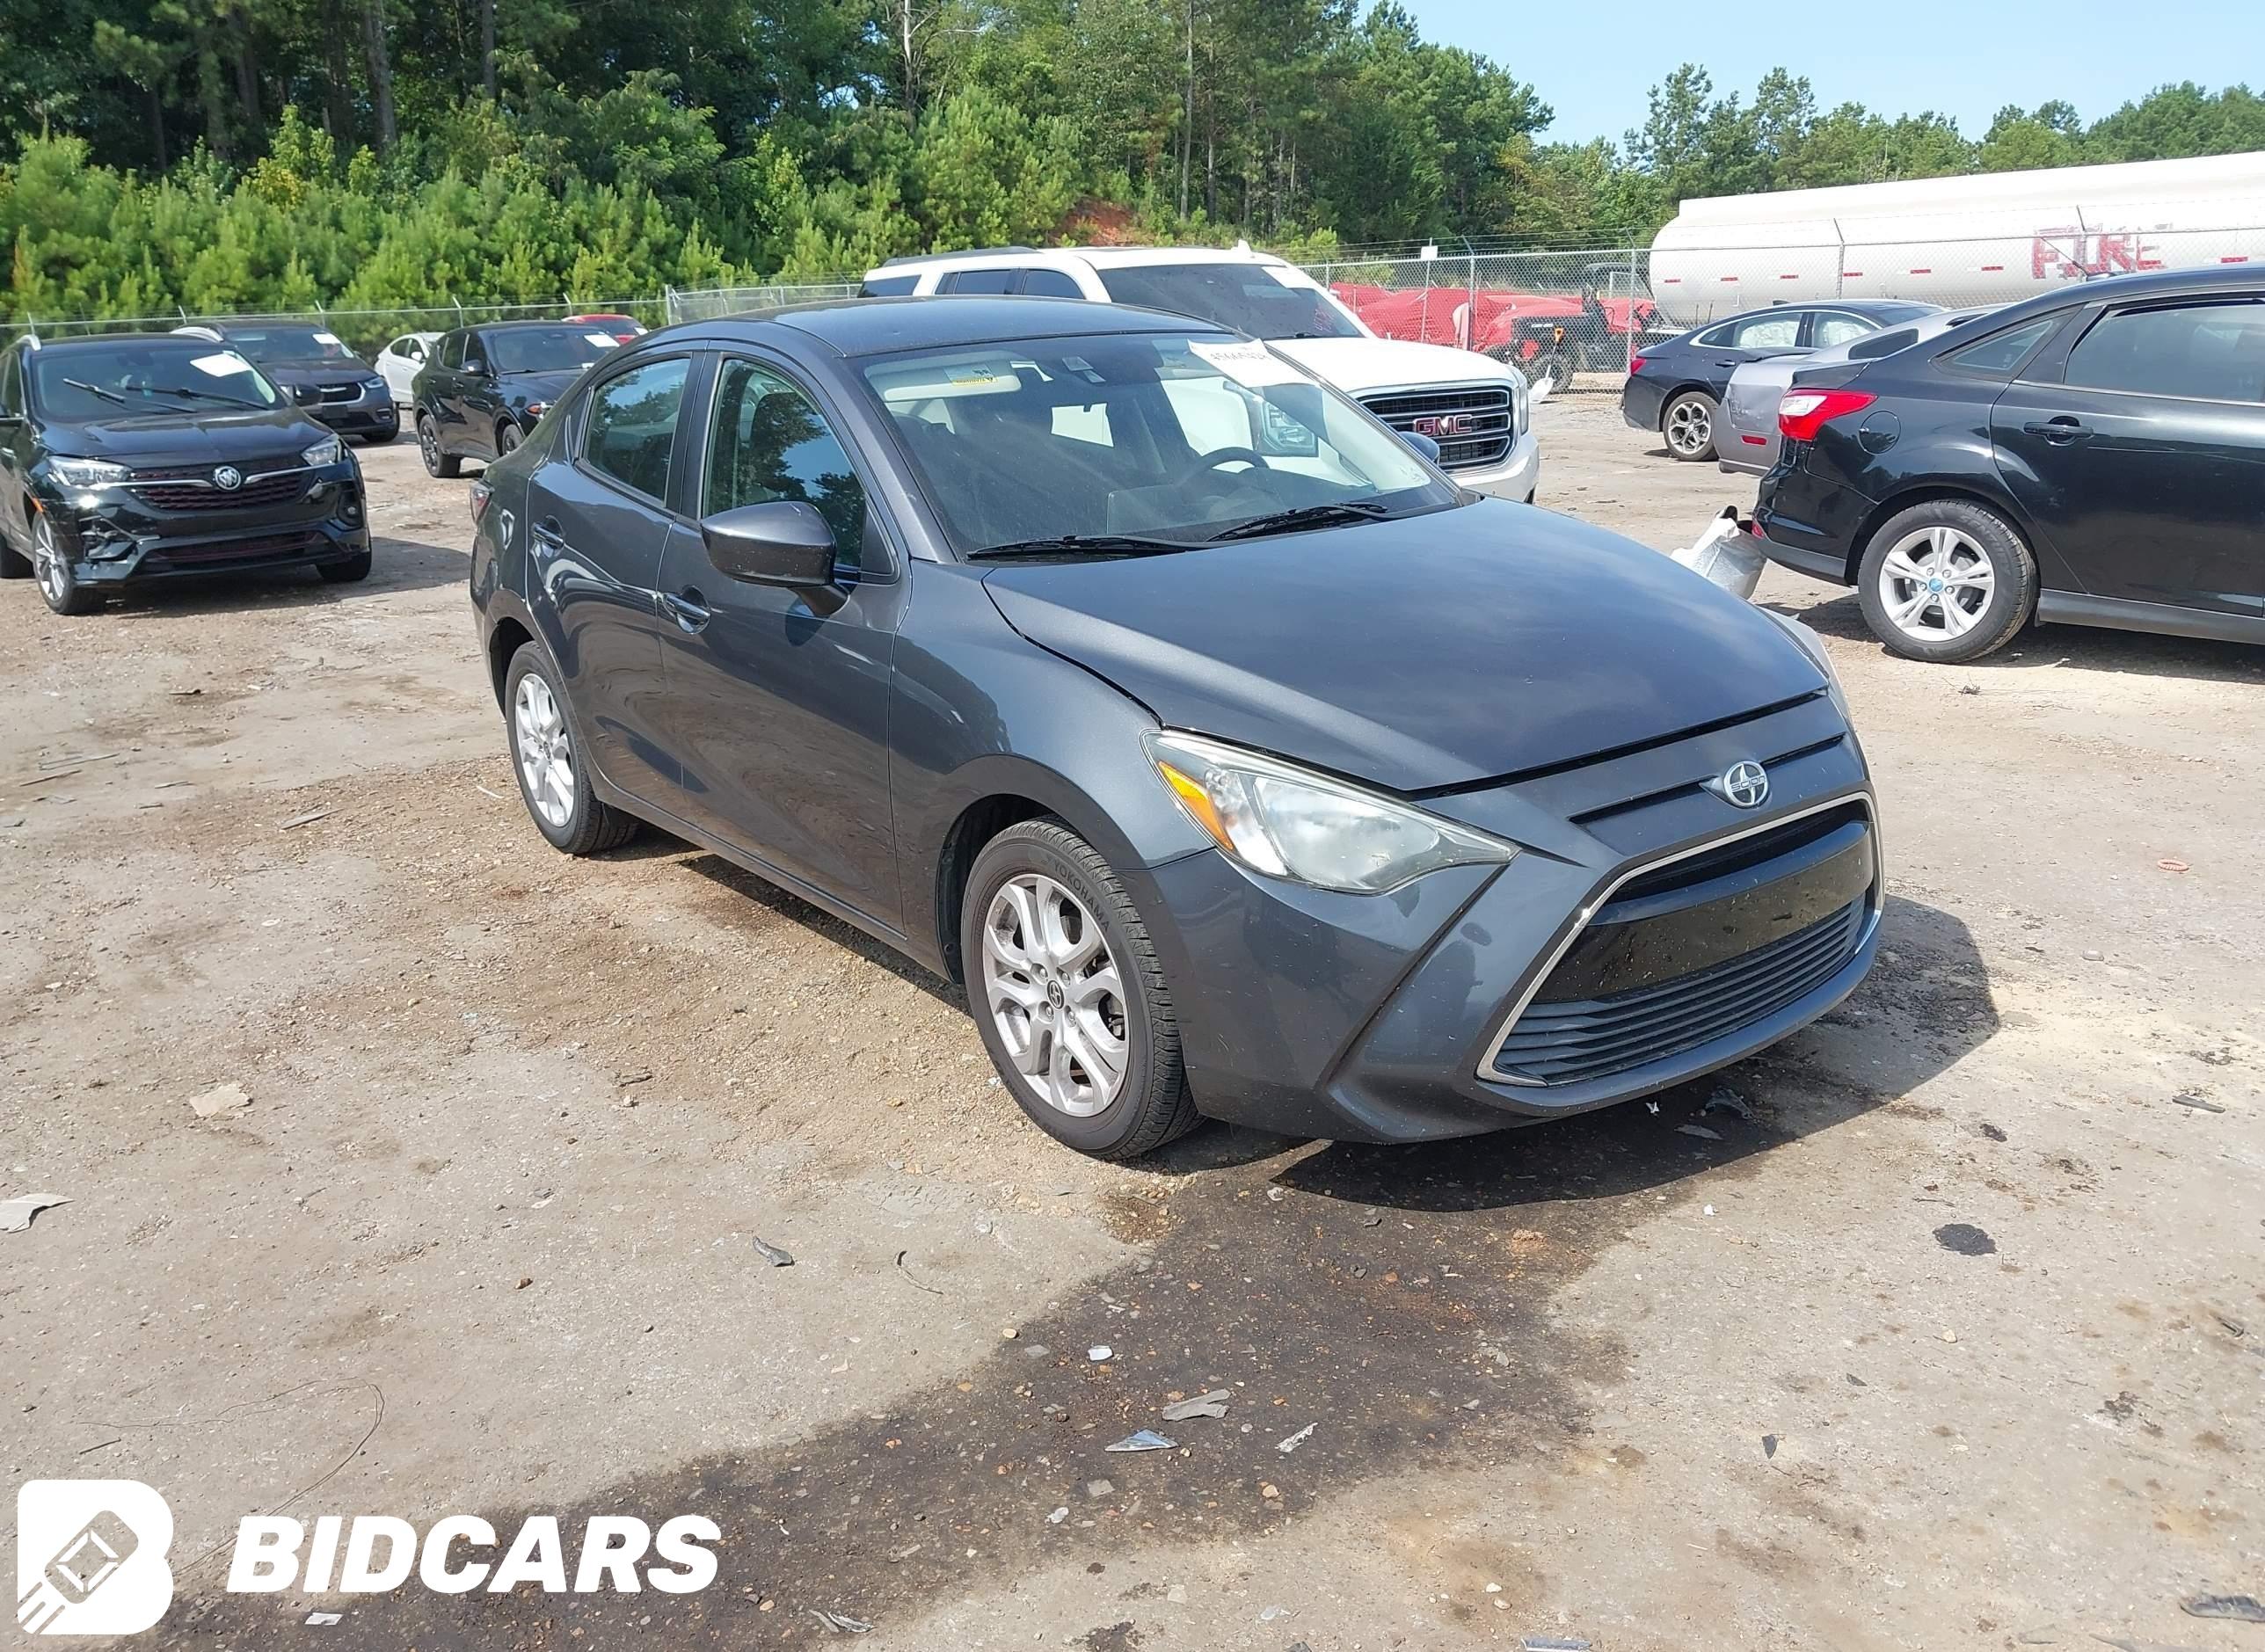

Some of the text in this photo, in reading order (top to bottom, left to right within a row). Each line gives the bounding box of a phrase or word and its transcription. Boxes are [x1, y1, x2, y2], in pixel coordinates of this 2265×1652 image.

[1413, 413, 1473, 437] GMC
[1730, 775, 1766, 793] SCION
[1055, 862, 1110, 932] YOKOHAMA
